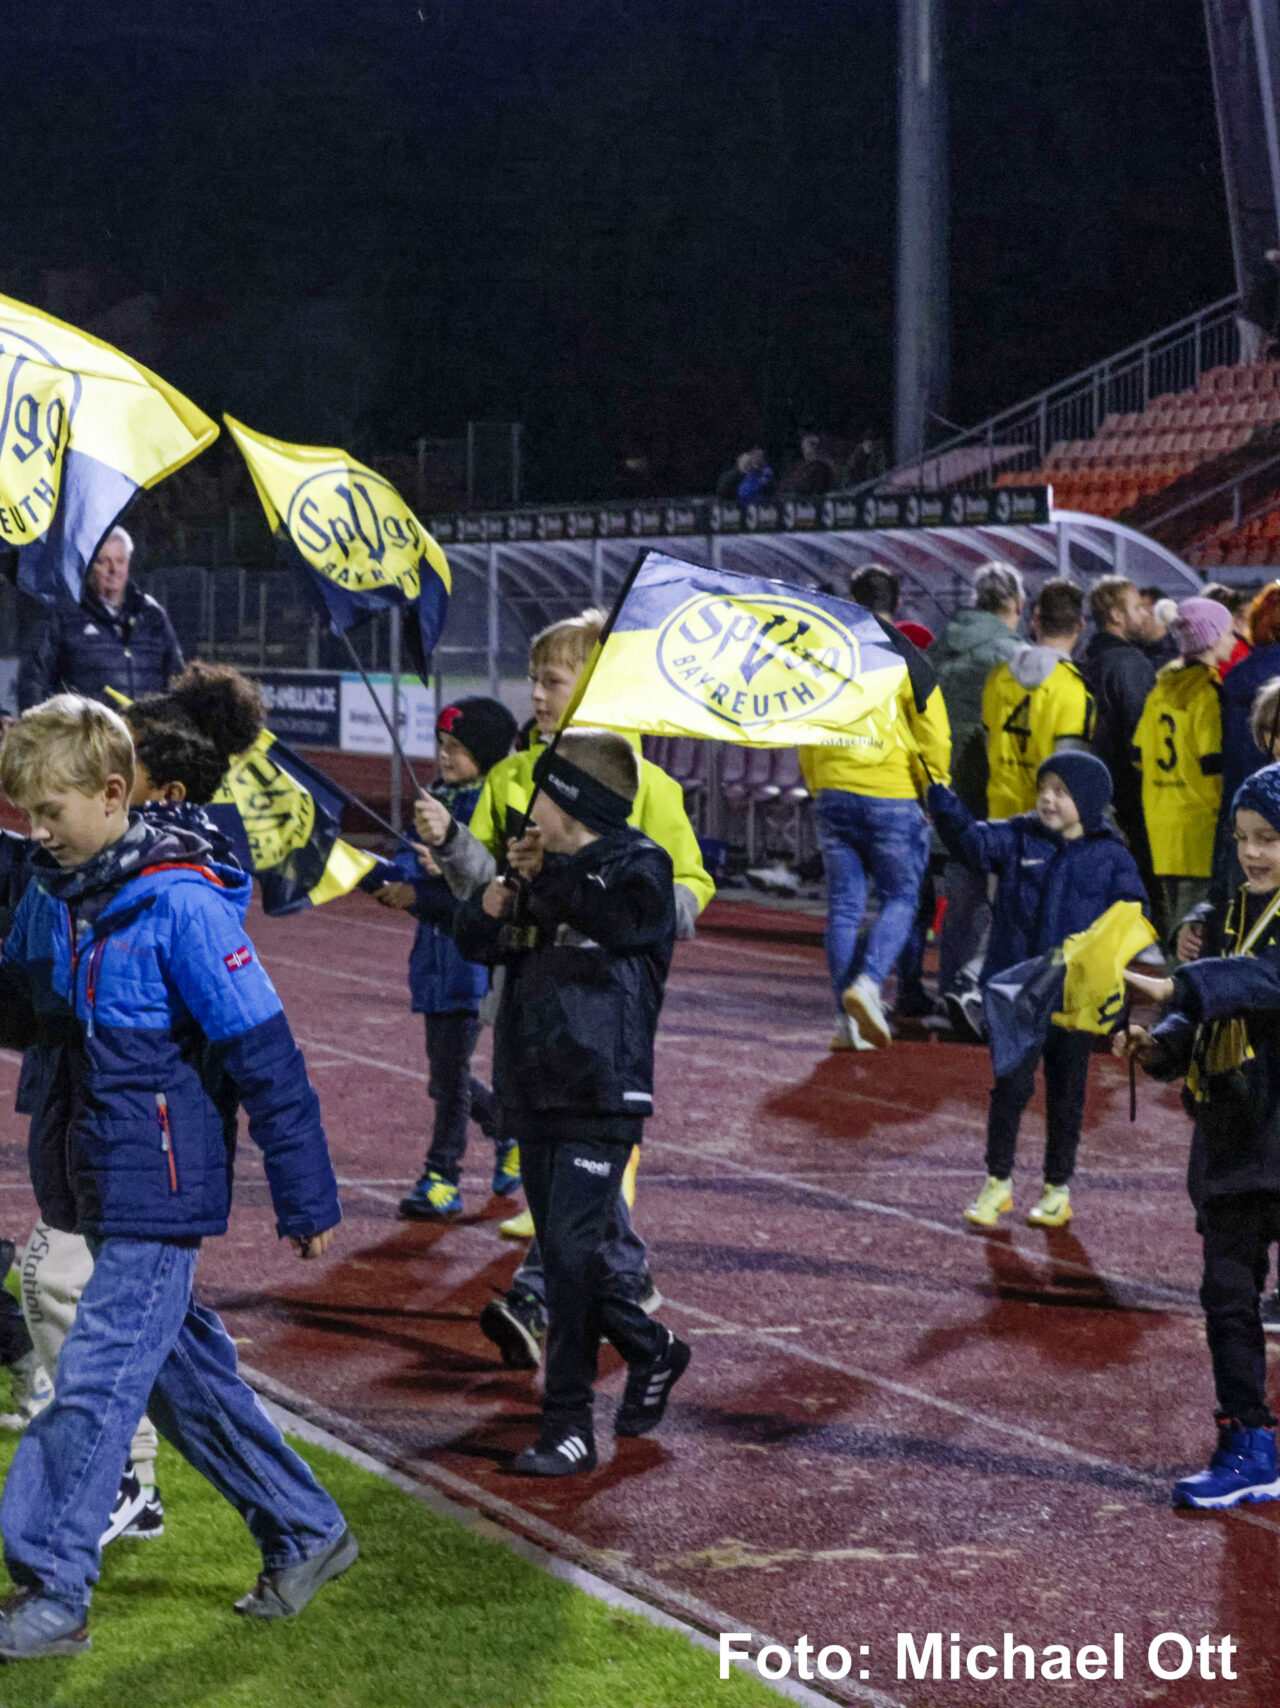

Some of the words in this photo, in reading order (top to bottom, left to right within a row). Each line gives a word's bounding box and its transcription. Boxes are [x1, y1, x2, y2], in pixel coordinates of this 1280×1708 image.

[297, 482, 420, 564] SpVgg
[678, 599, 842, 687] SpVgg
[672, 654, 816, 718] BAYREUTH
[1002, 694, 1032, 753] 4
[1157, 713, 1178, 772] 3
